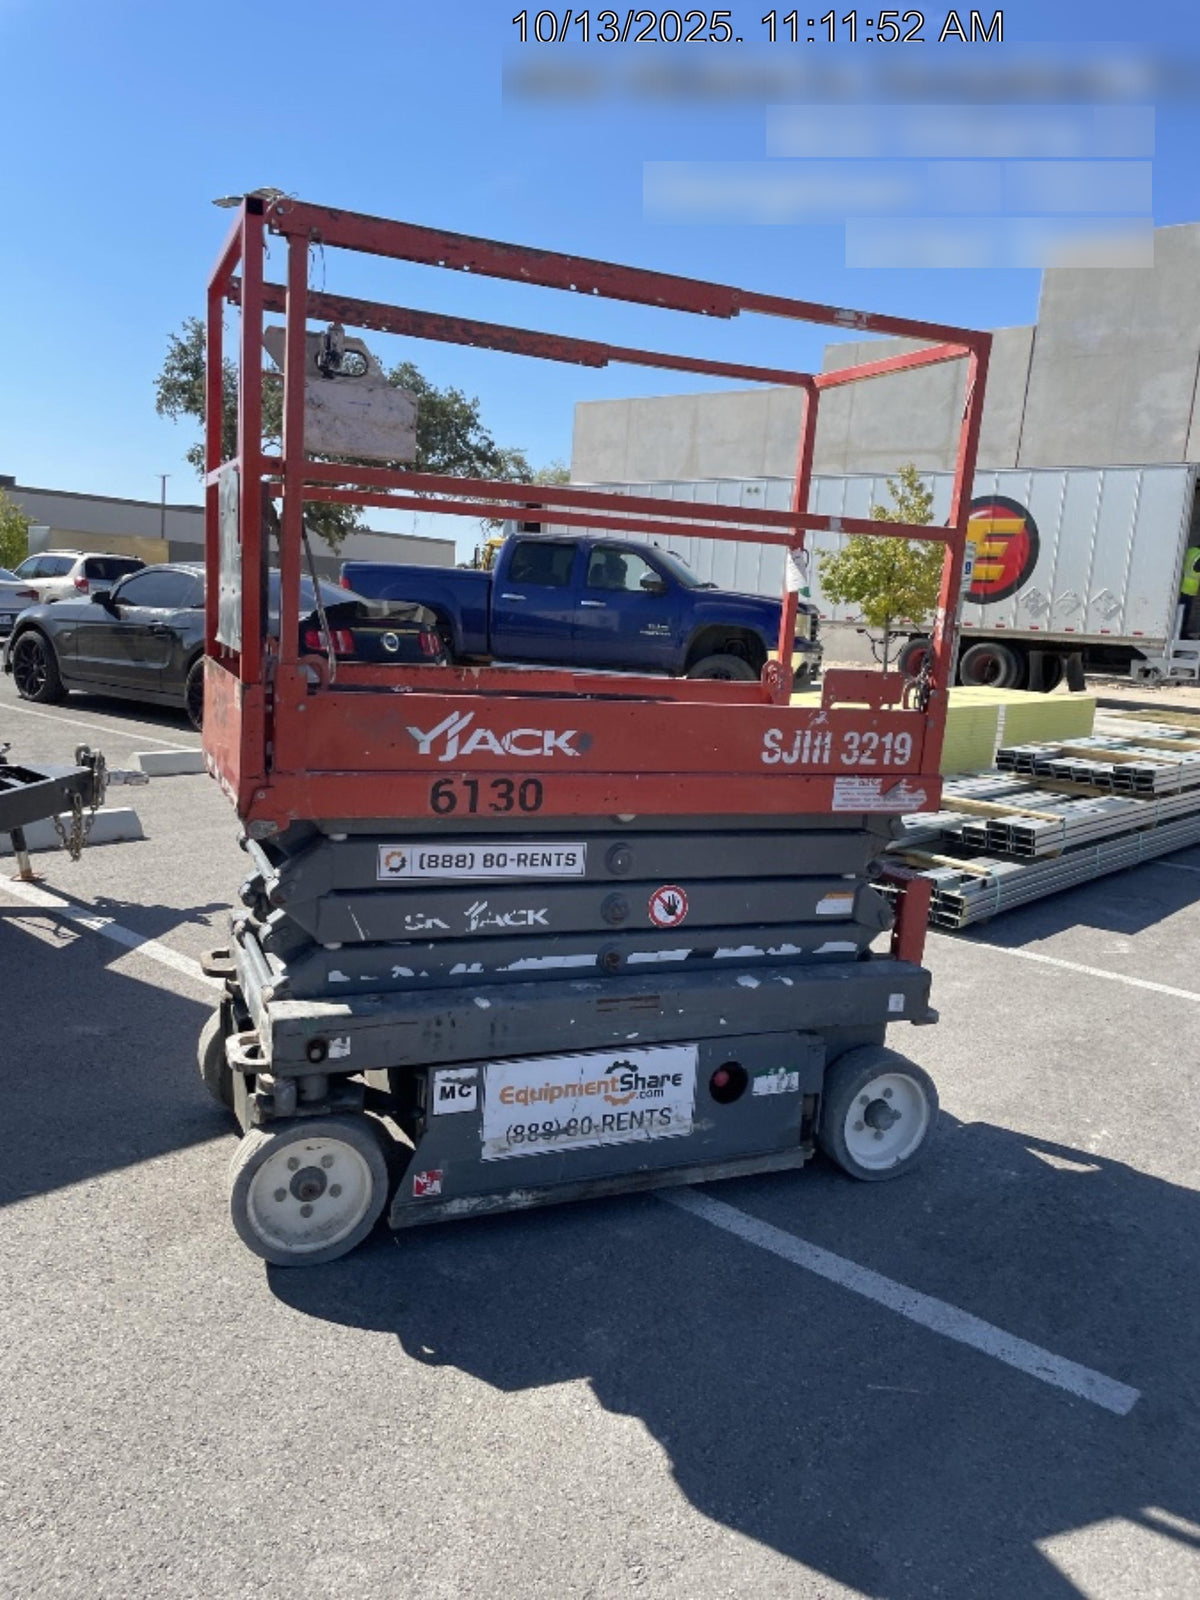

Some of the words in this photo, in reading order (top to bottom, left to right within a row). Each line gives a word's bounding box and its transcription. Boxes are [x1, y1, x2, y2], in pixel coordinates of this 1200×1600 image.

[840, 731, 913, 765] 3219
[430, 777, 544, 813] 6130
[418, 852, 475, 869] (888)
[482, 851, 577, 868] 80-RENTS
[439, 1084, 472, 1101] MC
[500, 1072, 683, 1106] EquipmentShare
[505, 1119, 560, 1145] (888)
[566, 1107, 672, 1137] 80-RENTS
